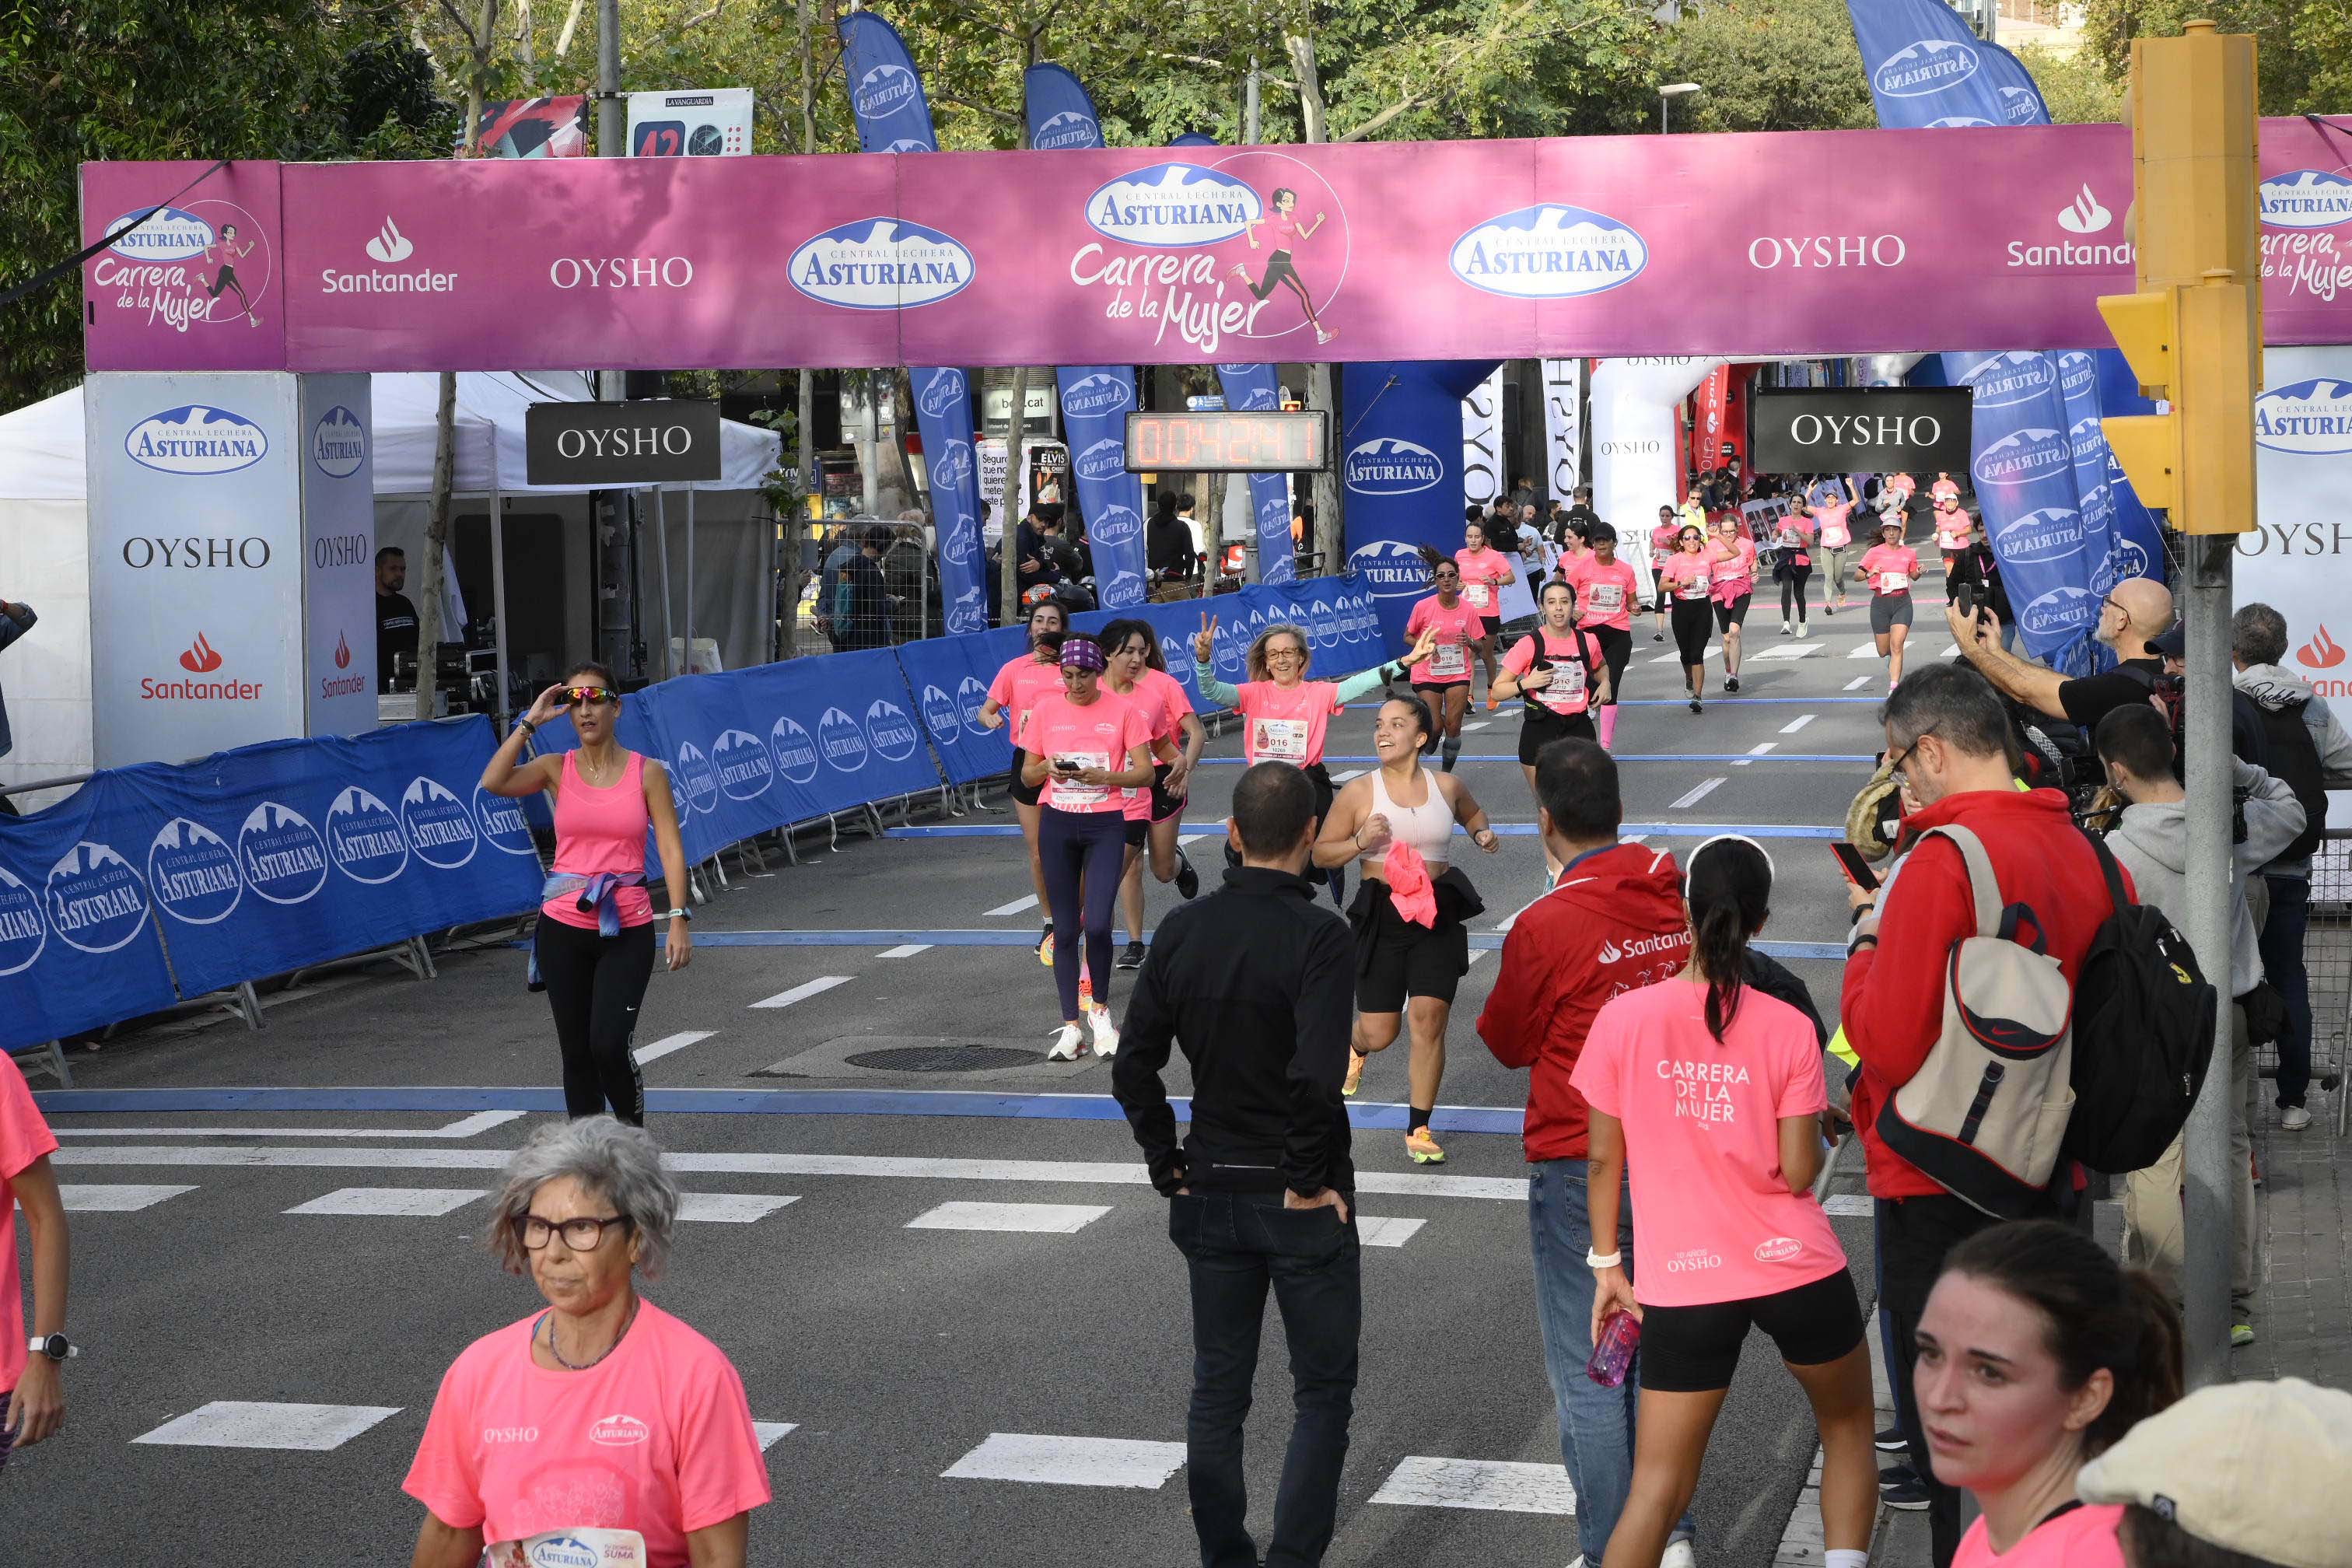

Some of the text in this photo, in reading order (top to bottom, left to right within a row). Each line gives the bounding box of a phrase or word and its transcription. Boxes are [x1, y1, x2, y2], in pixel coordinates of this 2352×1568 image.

[1125, 191, 1244, 201] CENTRAL LECHERA
[2260, 191, 2352, 213] STURIAN
[1099, 194, 1248, 226] ASTURIANA
[111, 226, 206, 247] ASTURIANA
[1563, 234, 1626, 246] LECHERA
[2260, 233, 2335, 255] arrera
[831, 248, 954, 259] CENTRAL LECHERA
[1070, 243, 1216, 287] Carrera
[1465, 240, 1633, 275] ASTURIANA
[1748, 234, 1906, 269] OYSHO
[2007, 240, 2136, 267] Santand
[94, 257, 186, 288] Carrera
[322, 268, 458, 293] Santander
[550, 257, 693, 289] OYSHO
[802, 251, 961, 285] ASTURIANA
[2279, 255, 2292, 277] la
[2289, 250, 2352, 302] Muje
[117, 285, 221, 333] de la Mujer
[1106, 282, 1270, 354] de la Mujer
[1791, 415, 1941, 446] OYSHO
[2256, 408, 2352, 436] ASTURI
[135, 430, 257, 457] ASTURIANA
[317, 432, 362, 460] ASTURIANA
[557, 425, 692, 459] OYSHO
[1601, 440, 1660, 455] OYSHO
[1041, 453, 1065, 463] ELVIS
[1348, 461, 1436, 482] ASTURIANA
[123, 537, 270, 569] OYSHO
[315, 534, 366, 569] OYSHO
[2235, 522, 2352, 557] OYSH
[141, 677, 263, 700] Santander
[322, 673, 365, 699] Santander
[776, 744, 816, 770] ASTURIANA
[825, 733, 866, 758] ASTURIANA
[716, 757, 772, 787] ASTURIANA
[341, 819, 368, 832] CENTRAL
[408, 813, 474, 849] ASTURIANA
[481, 802, 530, 836] ASTUR
[254, 831, 313, 849] CENTRAL LECHERA
[334, 826, 405, 863] ASTURIANA
[245, 845, 324, 884] ASTURIANA
[158, 863, 239, 904] ASTURIANA
[55, 885, 144, 932] ASTURIANA
[1622, 926, 1692, 958] Santand
[1657, 1060, 1750, 1085] CARRERA
[1675, 1080, 1731, 1103] DE LA
[1675, 1101, 1734, 1122] MUJER
[1668, 1255, 1721, 1273] OYSHO
[1686, 1248, 1707, 1258] AÑOS
[1759, 1244, 1800, 1259] ASTURIANA
[484, 1427, 538, 1444] OYSHO
[595, 1426, 644, 1439] ASTURIANA
[537, 1546, 593, 1568] ASTURIANA
[604, 1550, 634, 1560] SUMA
